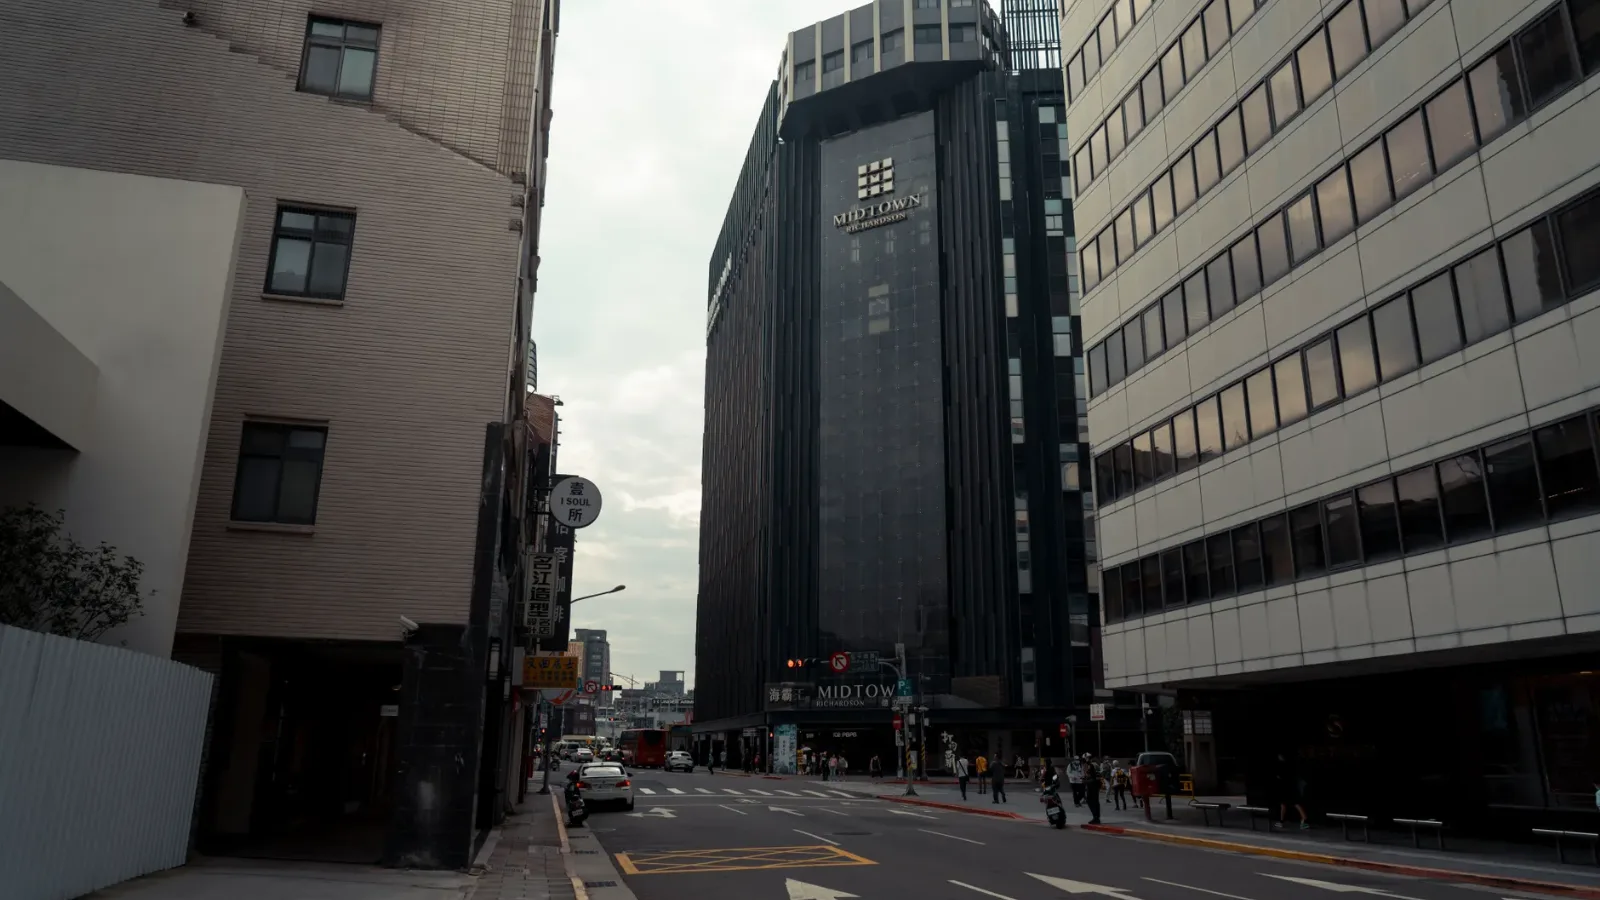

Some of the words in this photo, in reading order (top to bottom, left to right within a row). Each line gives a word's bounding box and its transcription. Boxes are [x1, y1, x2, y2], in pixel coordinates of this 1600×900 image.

[833, 193, 921, 226] MIDTOWN
[846, 213, 906, 232] RICHARDSON
[570, 482, 584, 496] 壹
[566, 498, 591, 506] SOUL
[568, 508, 582, 523] 所
[528, 555, 553, 617] 名江造型
[769, 687, 806, 703] 海霸王
[817, 684, 896, 699] MIDTOW
[816, 700, 865, 708] RICHARDSON
